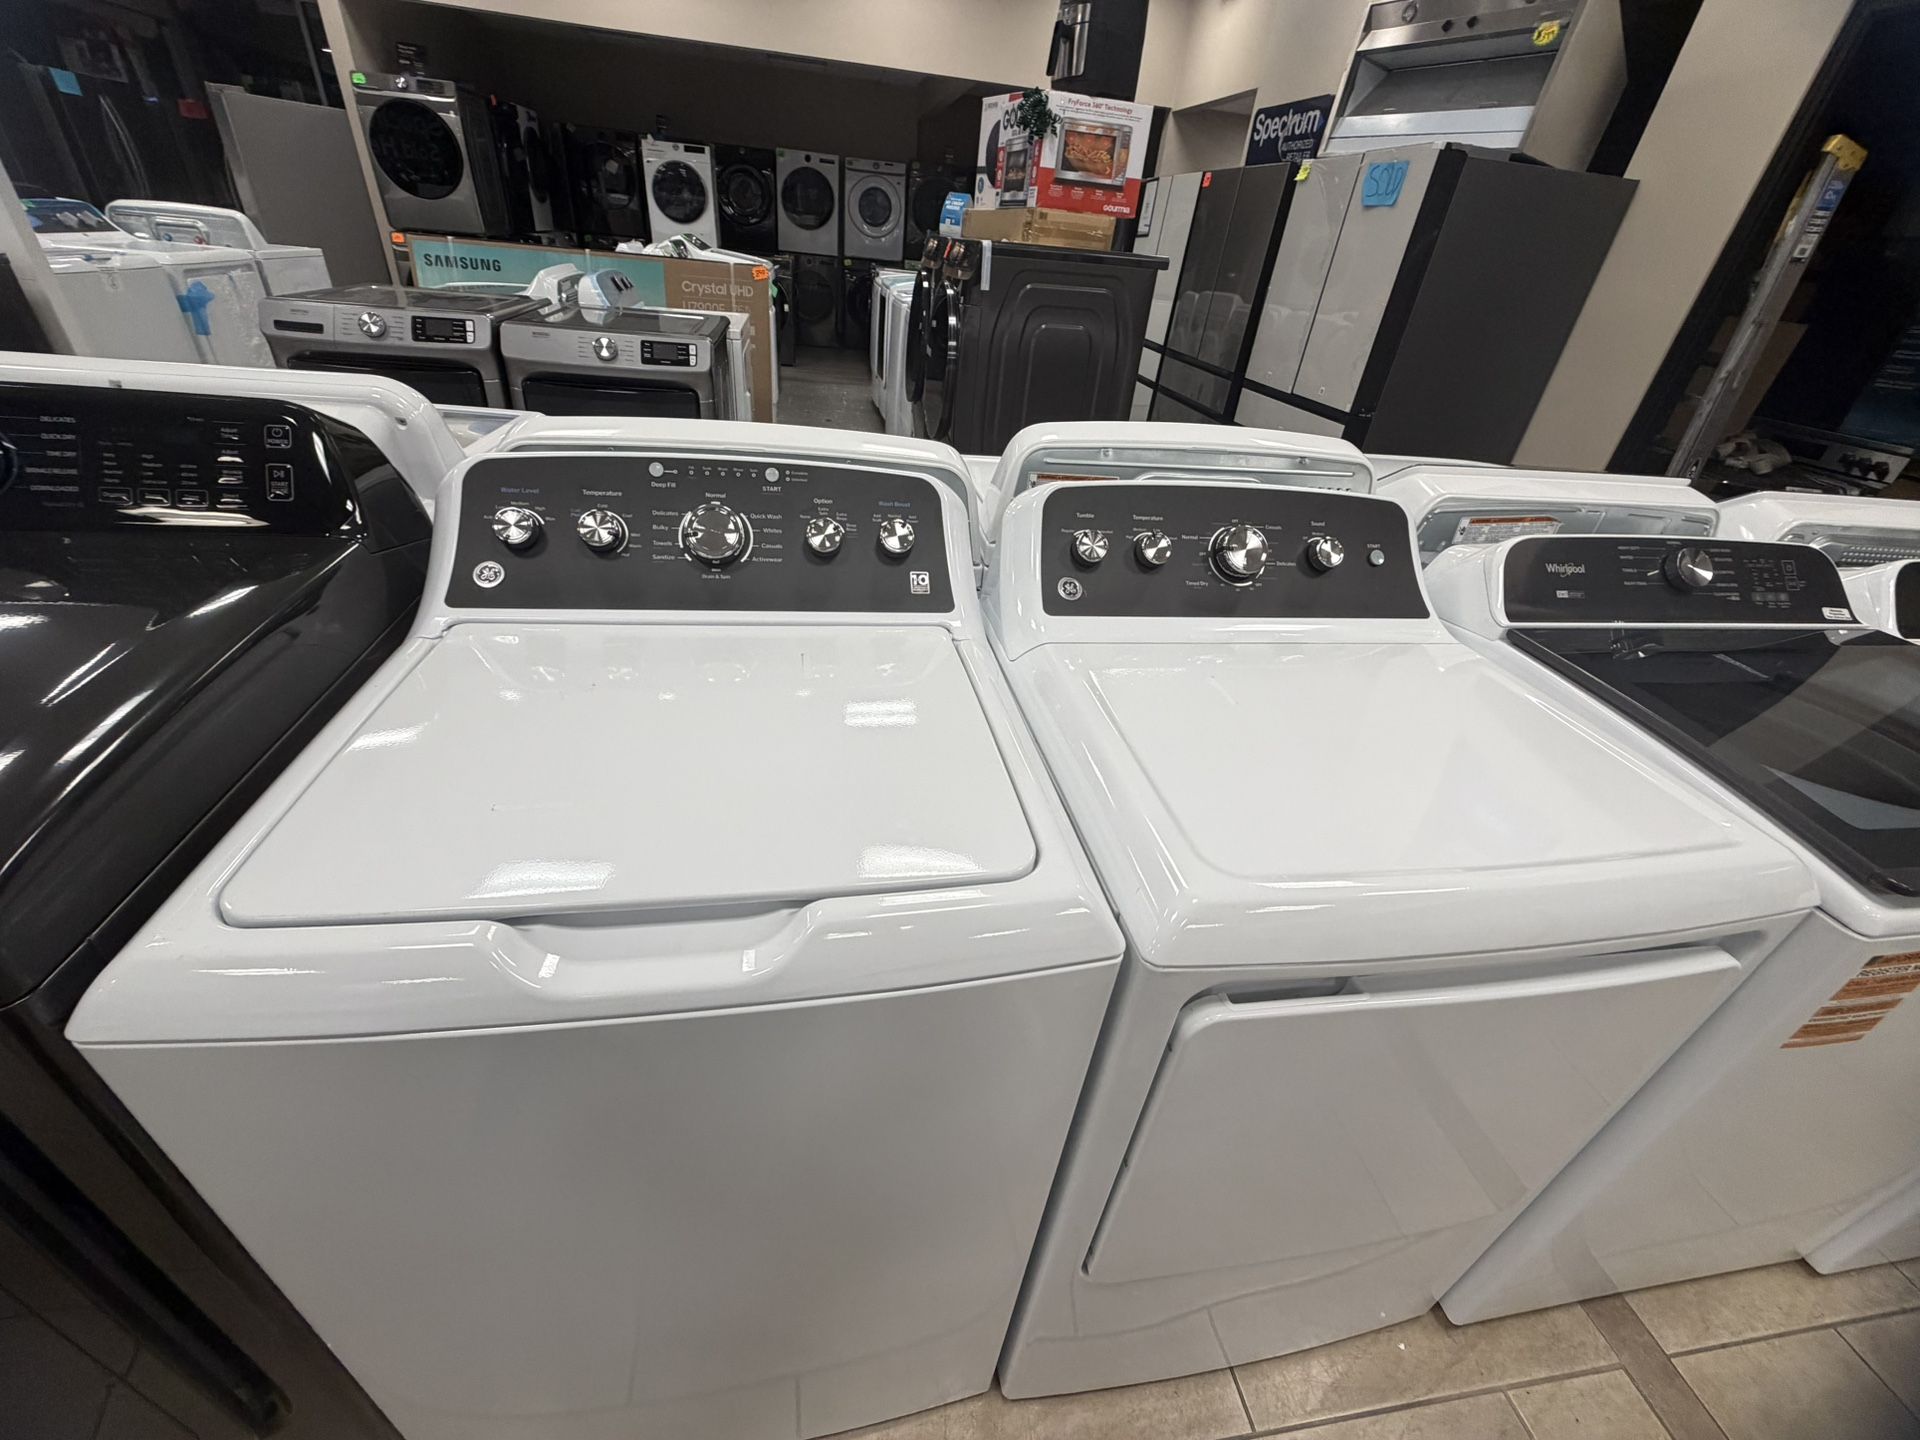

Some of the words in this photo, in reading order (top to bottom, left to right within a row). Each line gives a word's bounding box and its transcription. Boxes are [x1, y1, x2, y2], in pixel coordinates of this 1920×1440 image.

[1253, 109, 1321, 147] Spectrum
[1281, 138, 1314, 150] AUTHORIZED
[423, 253, 502, 272] SAMSUNG
[681, 281, 727, 296] Crystal
[730, 285, 754, 297] UHD
[521, 486, 540, 494] Level
[582, 488, 622, 497] Temperature
[1133, 514, 1164, 522] Temperature
[652, 524, 669, 532] Bulky
[1545, 563, 1586, 578] Whirlpool
[911, 574, 929, 586] 10
